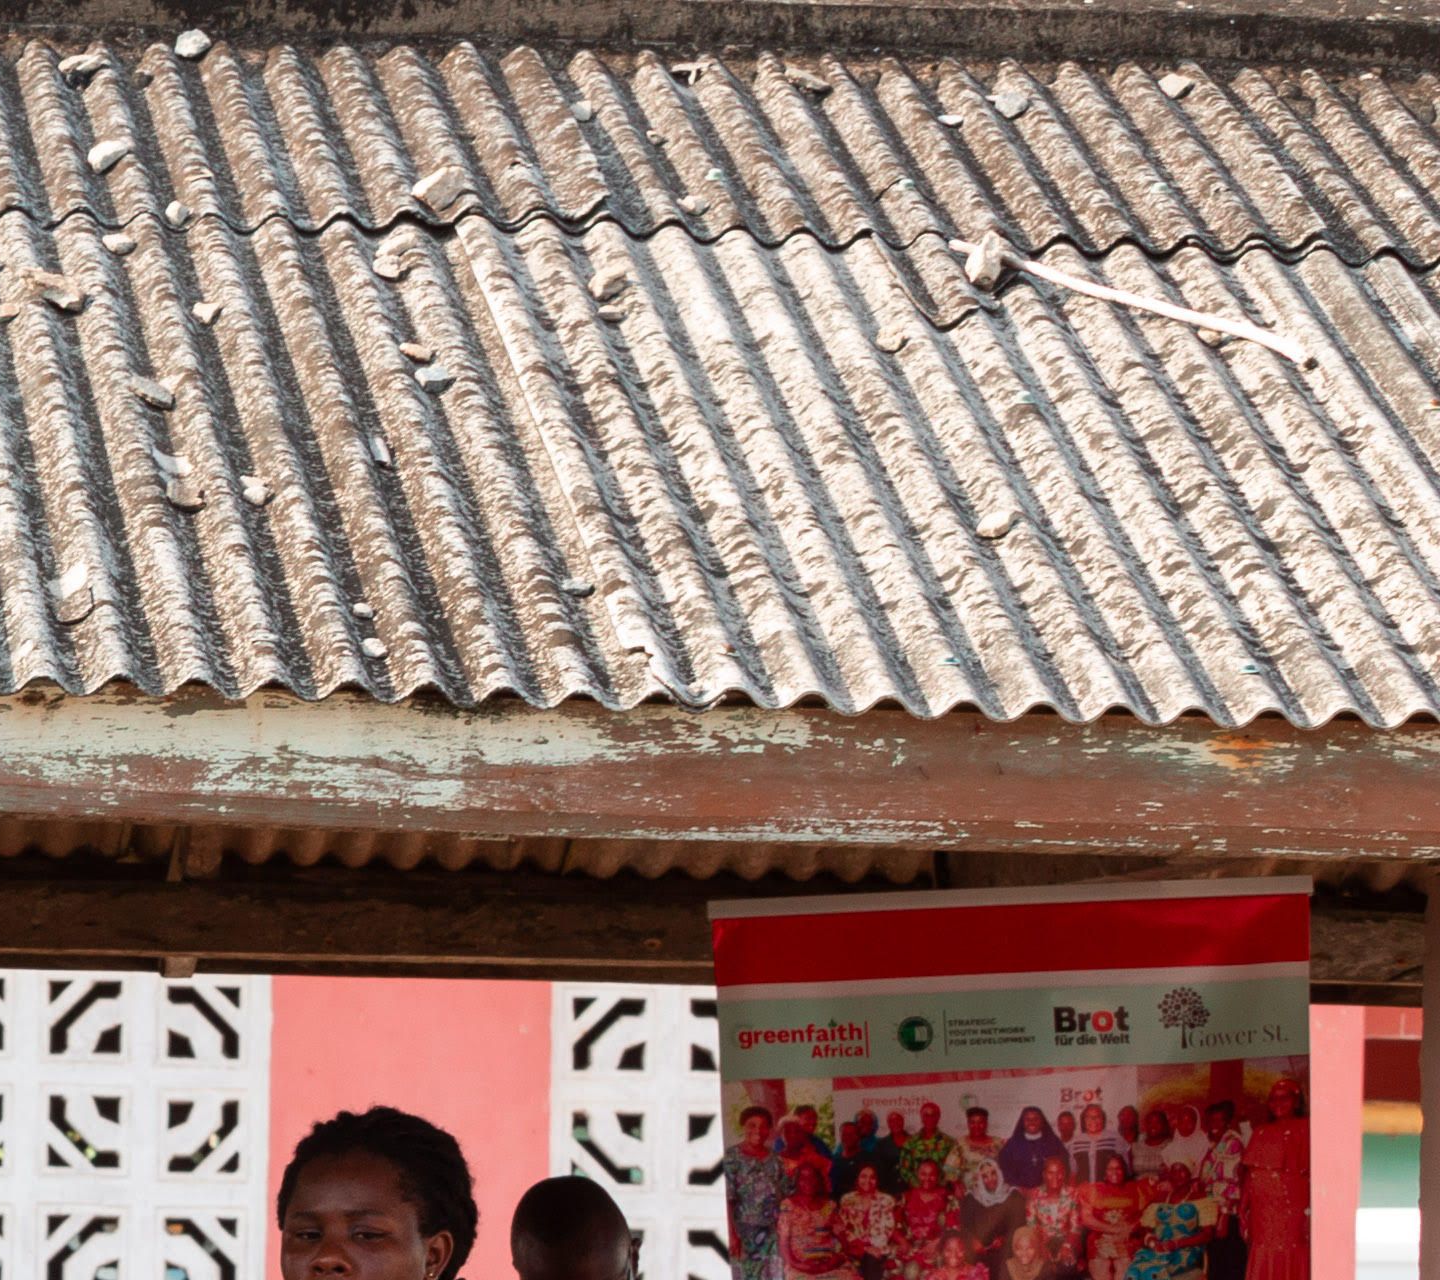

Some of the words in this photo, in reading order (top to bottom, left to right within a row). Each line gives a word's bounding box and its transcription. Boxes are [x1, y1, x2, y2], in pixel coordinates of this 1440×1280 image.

[948, 1018, 997, 1027] STRATEGIC
[1053, 1006, 1130, 1033] Brot
[738, 1019, 863, 1049] greenfaith
[948, 1028, 979, 1037] YOUTH
[981, 1026, 1026, 1035] NETWORK
[1188, 1027, 1258, 1049] Gower
[1262, 1023, 1289, 1043] St.
[948, 1038, 968, 1047] FOR
[970, 1036, 1036, 1046] DEVELOPMENT
[1054, 1034, 1074, 1046] für
[1076, 1034, 1097, 1045] die
[1099, 1033, 1130, 1045] Welt
[811, 1045, 864, 1058] Africa
